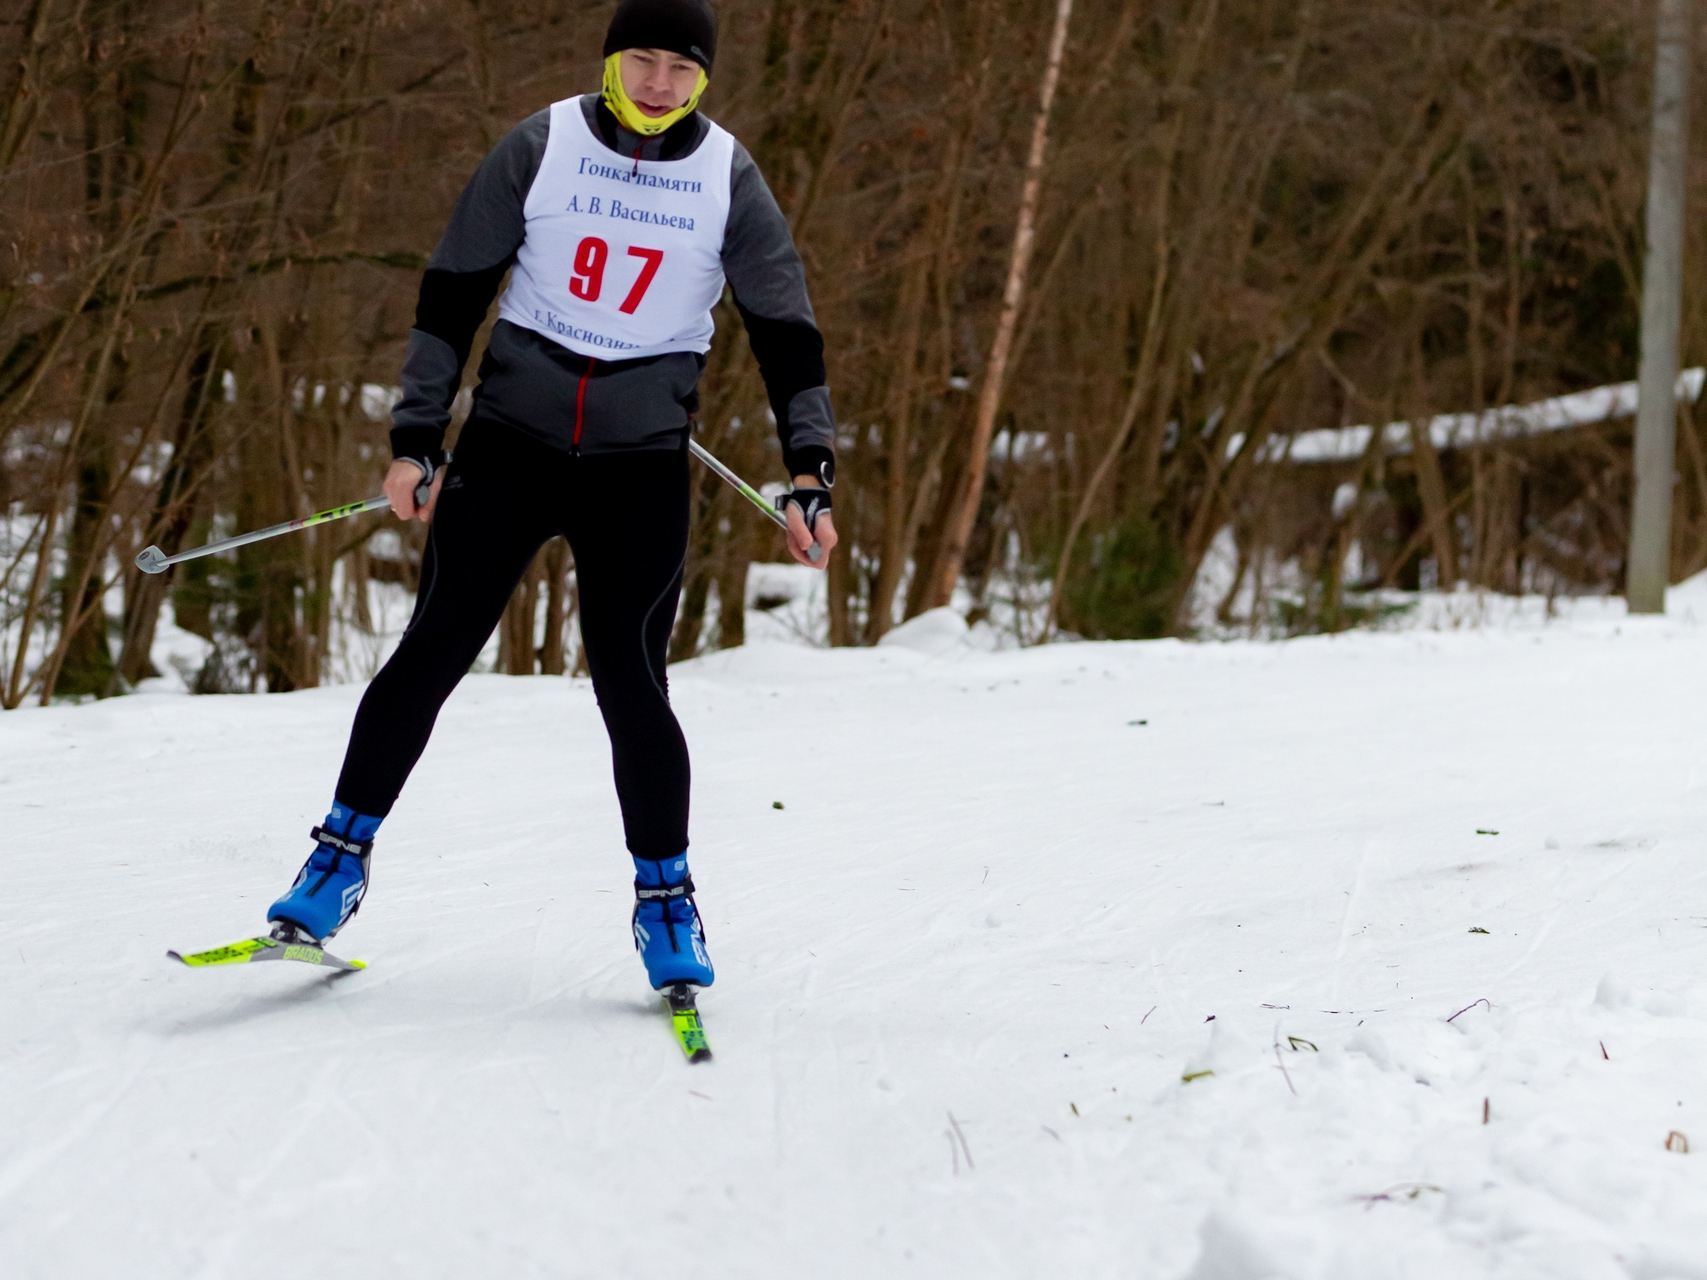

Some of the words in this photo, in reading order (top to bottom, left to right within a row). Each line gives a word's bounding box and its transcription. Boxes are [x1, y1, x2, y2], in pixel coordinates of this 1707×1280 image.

[578, 157, 632, 183] Гонка
[635, 173, 702, 193] памяти
[609, 199, 695, 231] Васильева
[568, 236, 664, 315] 97
[638, 886, 685, 899] SPINE
